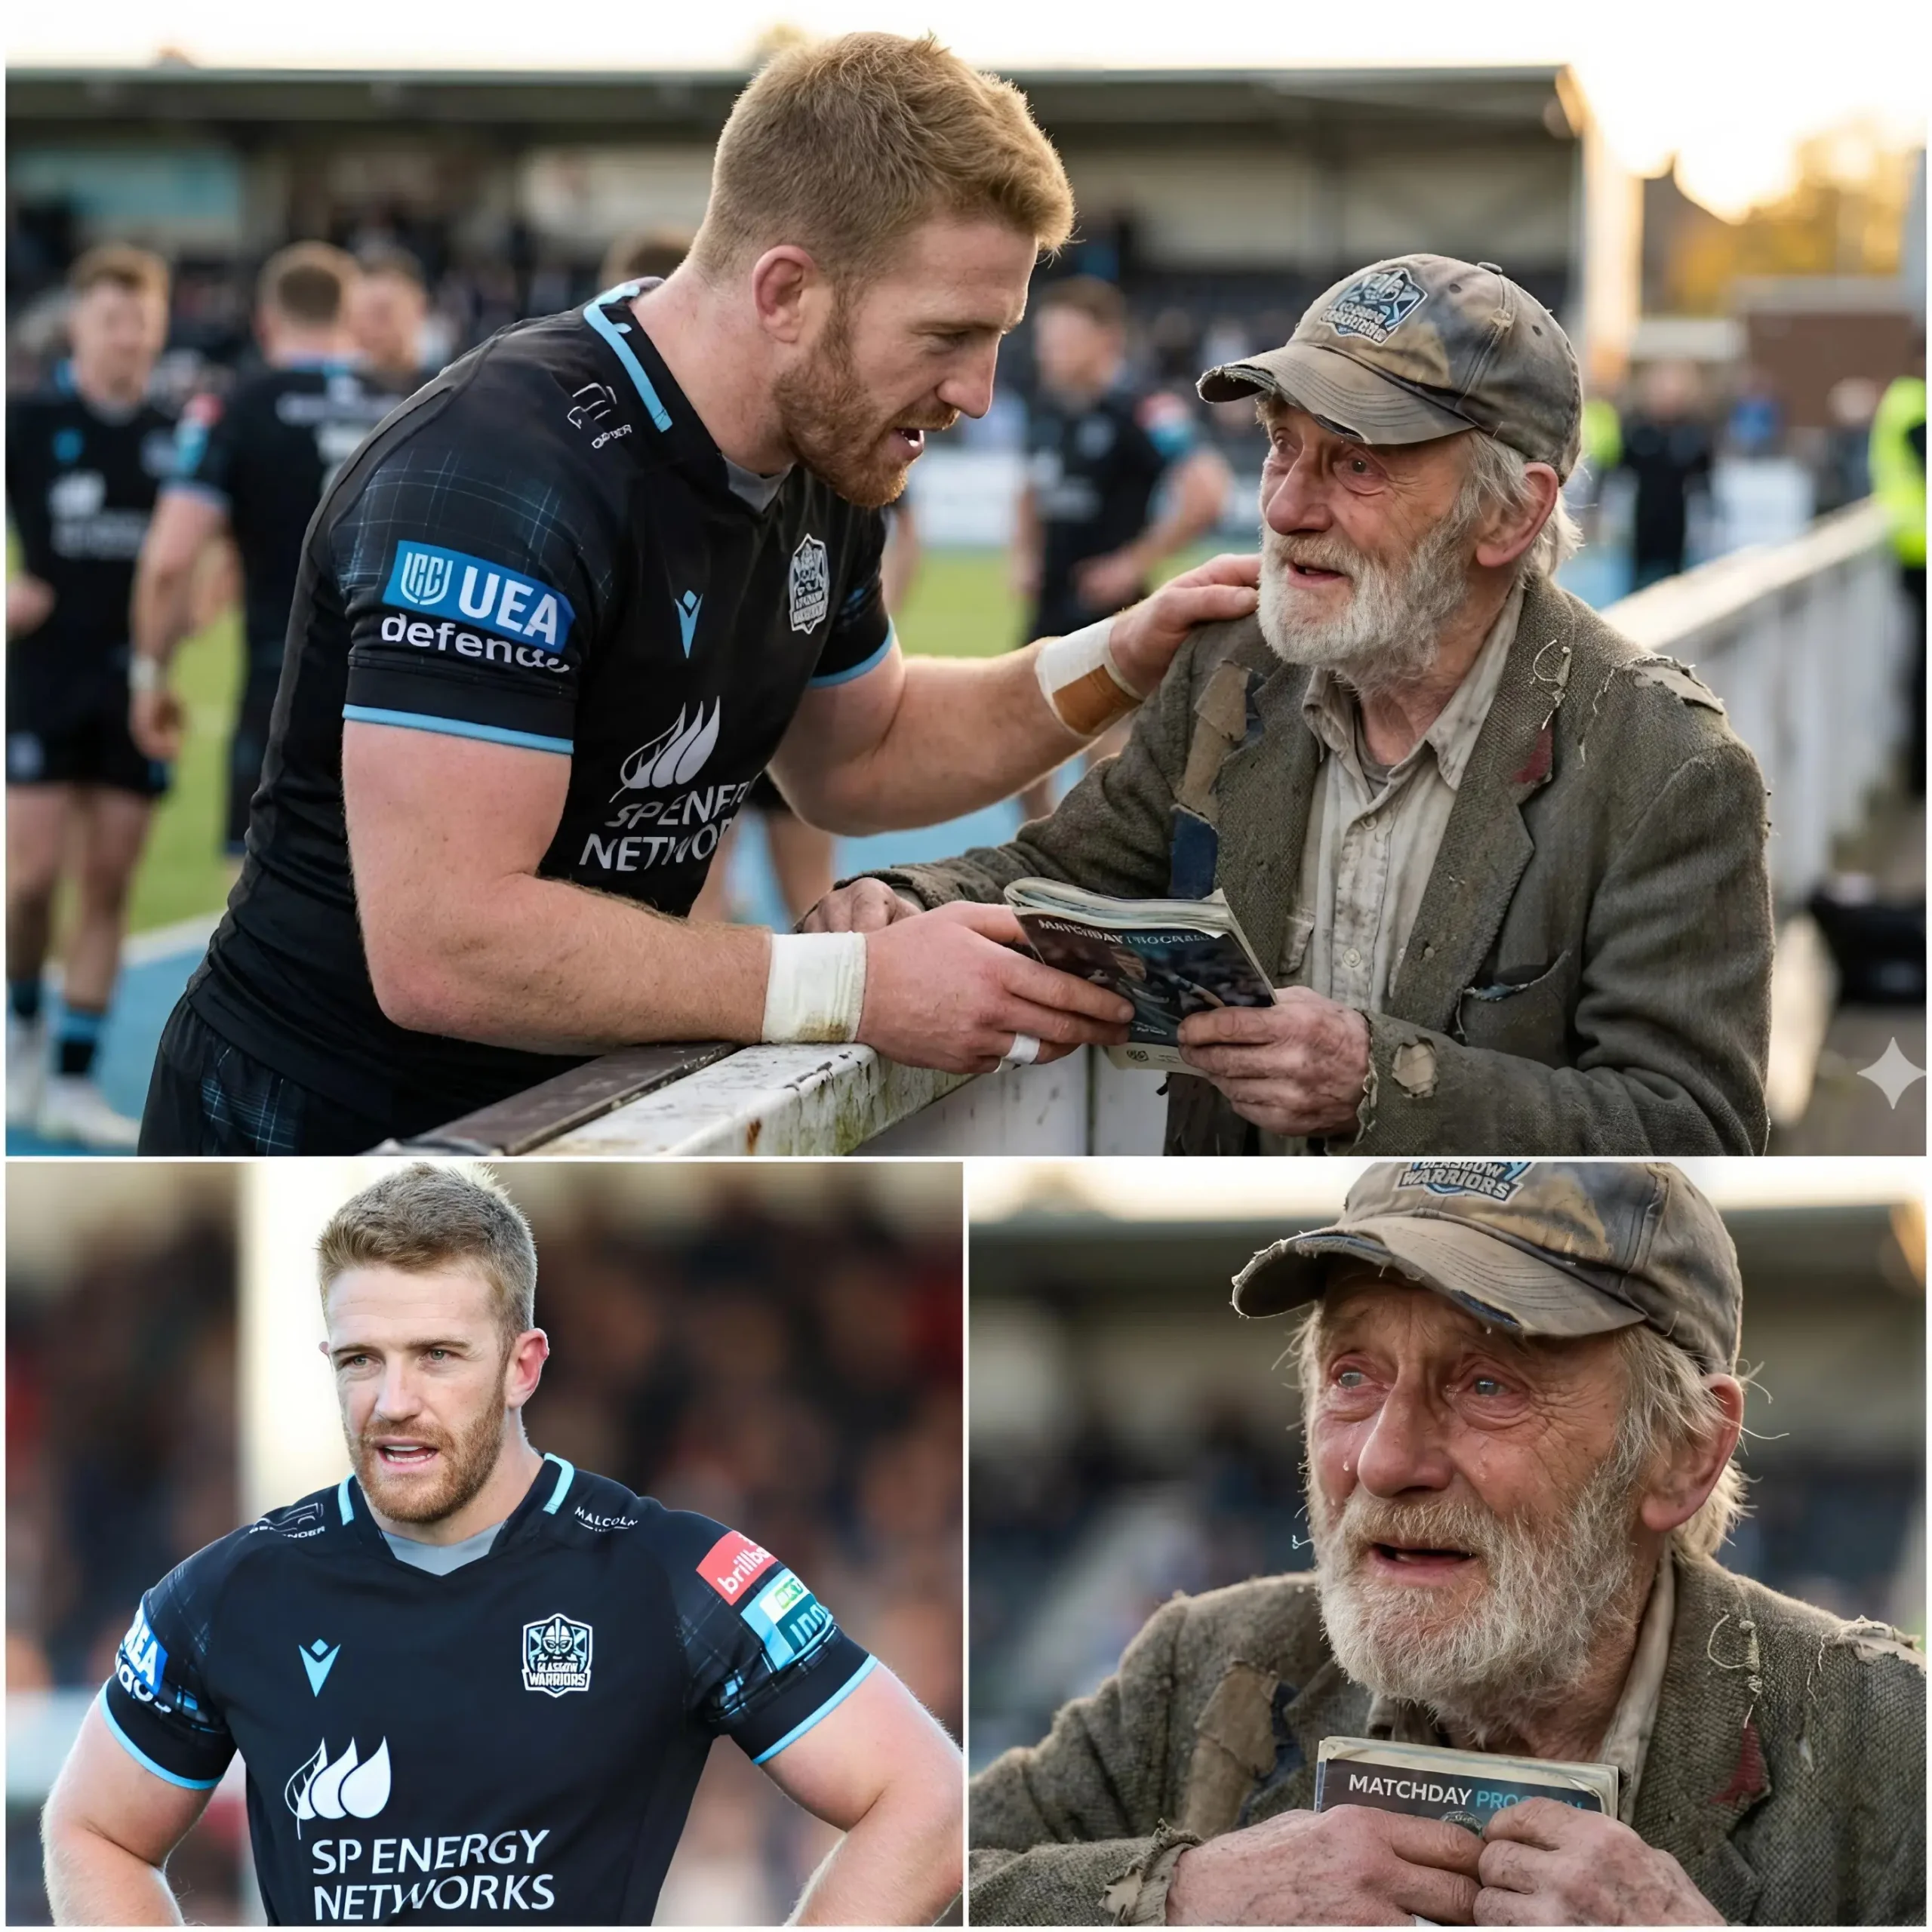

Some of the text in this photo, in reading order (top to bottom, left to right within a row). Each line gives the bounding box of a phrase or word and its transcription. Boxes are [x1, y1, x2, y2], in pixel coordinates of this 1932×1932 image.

[1401, 1169, 1510, 1199] WARRIORS
[528, 1672, 586, 1686] WARRIORS
[1349, 1774, 1472, 1806] MATCHDAY
[312, 1829, 550, 1875] SP ENERGY
[314, 1874, 555, 1921] NETWORKS
